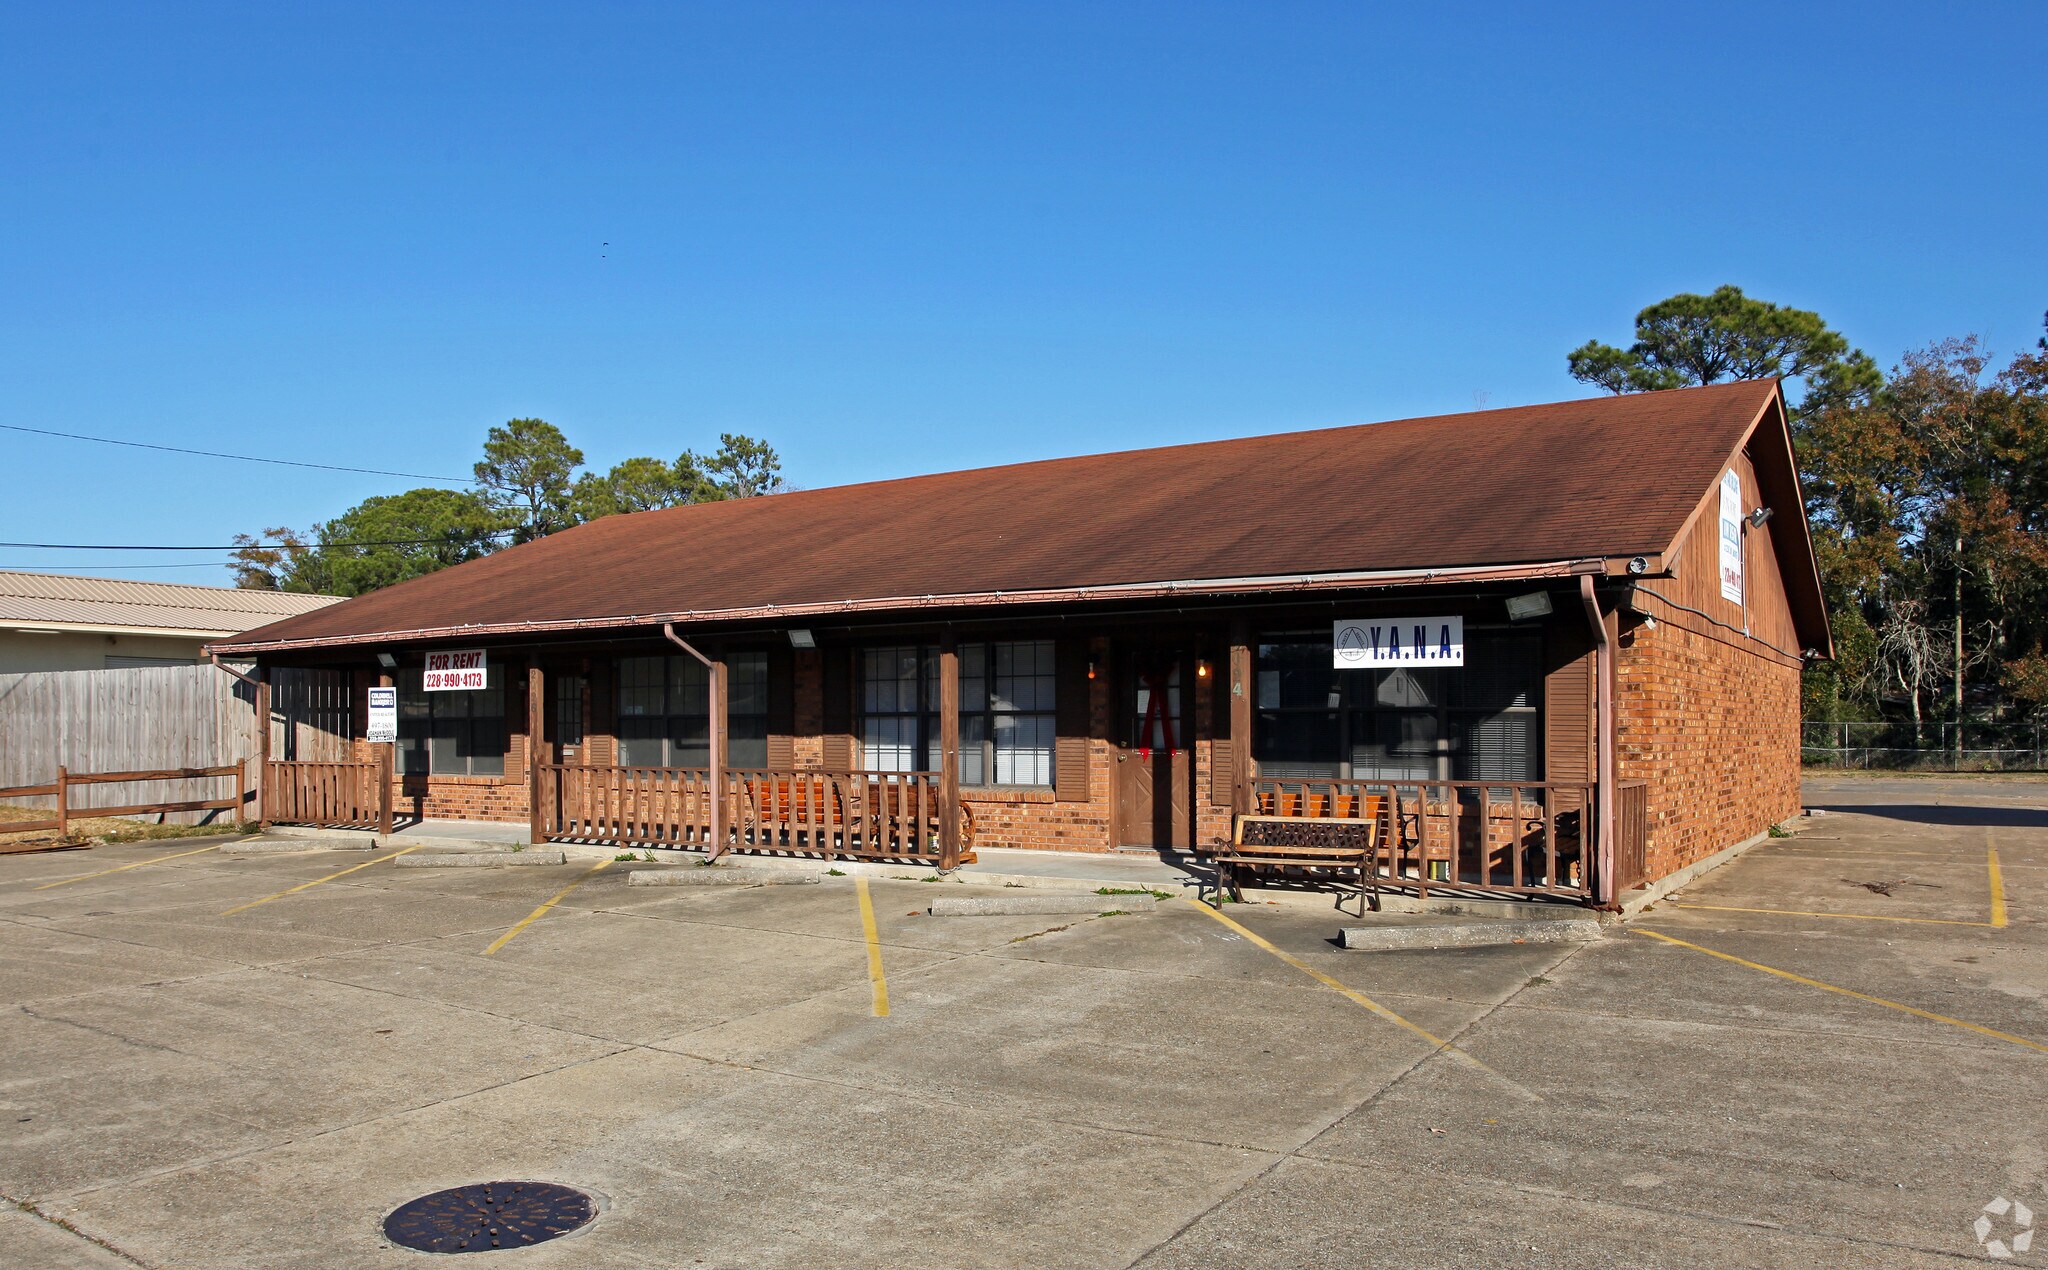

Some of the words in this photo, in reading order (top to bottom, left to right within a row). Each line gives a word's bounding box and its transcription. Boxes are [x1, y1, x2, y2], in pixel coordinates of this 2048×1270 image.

[1370, 624, 1462, 660] Y.A.N.A.
[429, 653, 450, 671] FOR
[452, 651, 482, 669] RENT
